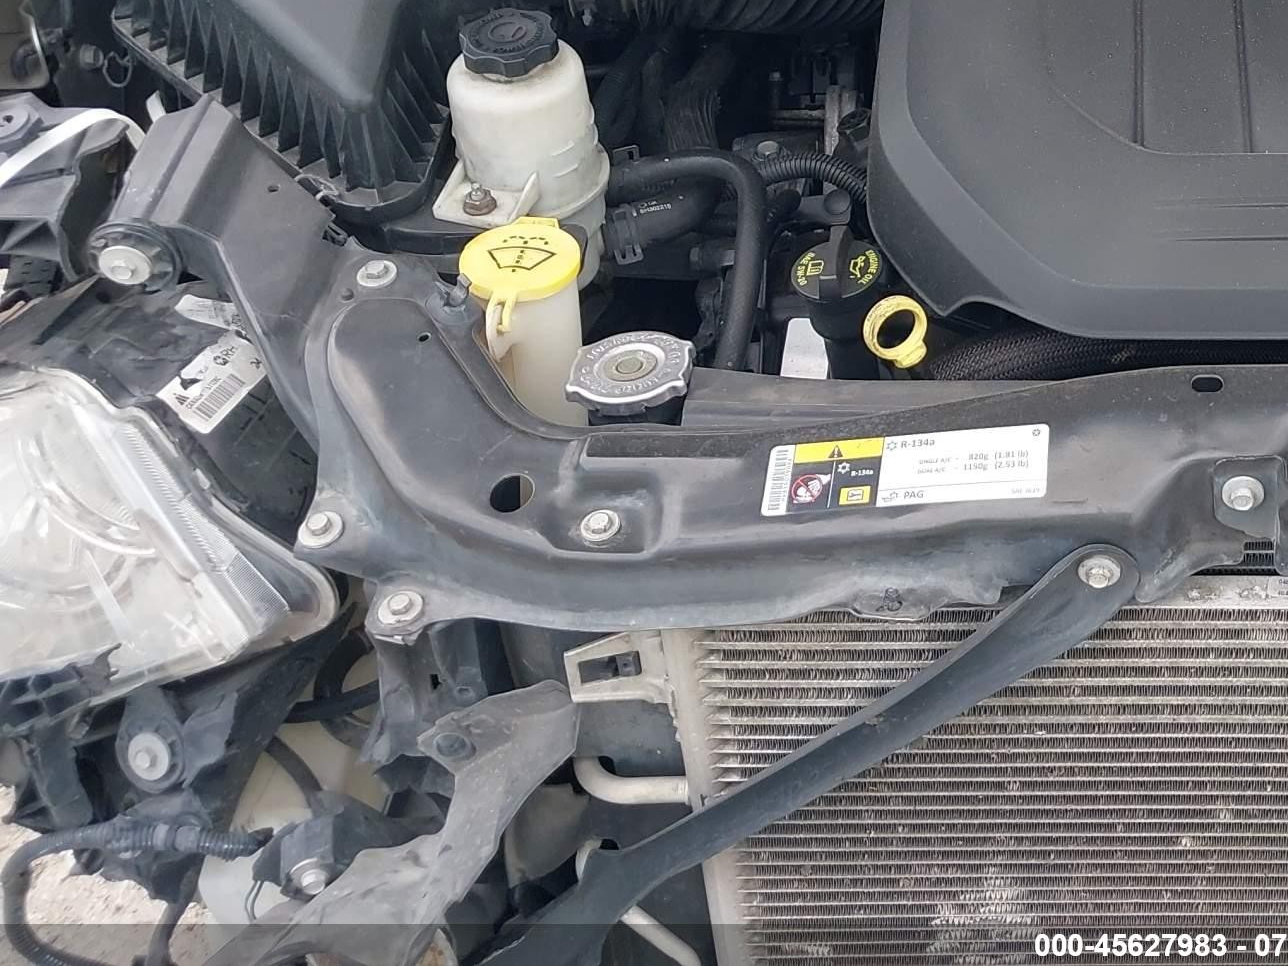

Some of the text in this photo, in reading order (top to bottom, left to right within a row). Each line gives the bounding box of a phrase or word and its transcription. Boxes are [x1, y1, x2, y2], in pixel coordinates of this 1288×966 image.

[857, 249, 879, 285] ENGINE OIL
[900, 438, 936, 449] R-134a
[903, 490, 925, 500] PAG
